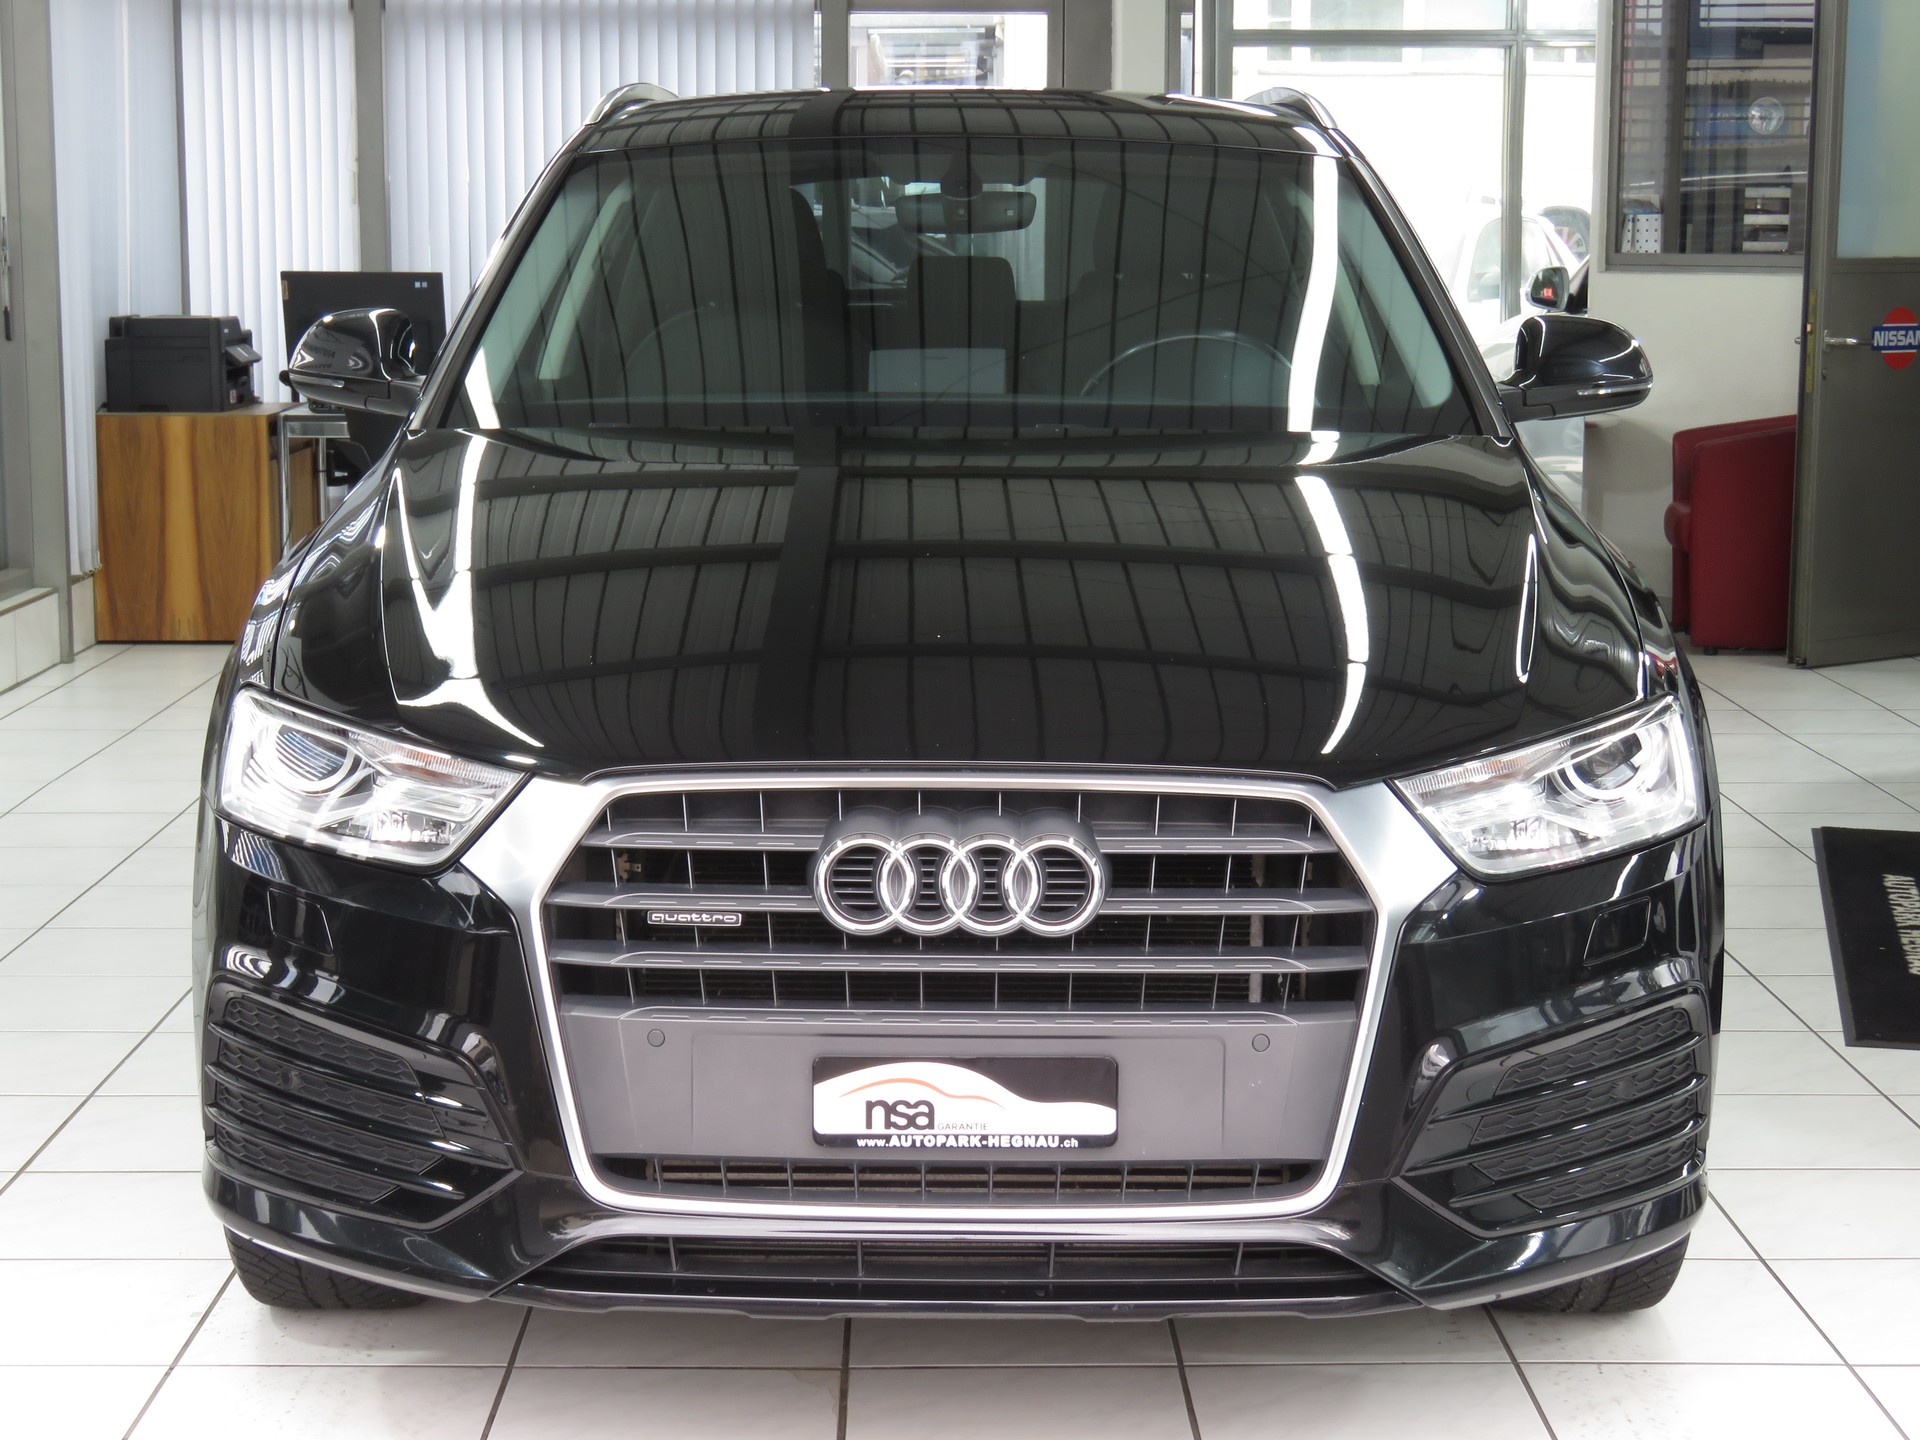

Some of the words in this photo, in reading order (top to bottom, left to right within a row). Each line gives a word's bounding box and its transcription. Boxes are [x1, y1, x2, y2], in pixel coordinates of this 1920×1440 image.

[651, 912, 737, 923] quattro
[865, 1099, 935, 1131] nsa
[937, 1122, 988, 1131] GARANTIE
[856, 1134, 1079, 1148] www.AUTOPARK-HEGNAU.ch
